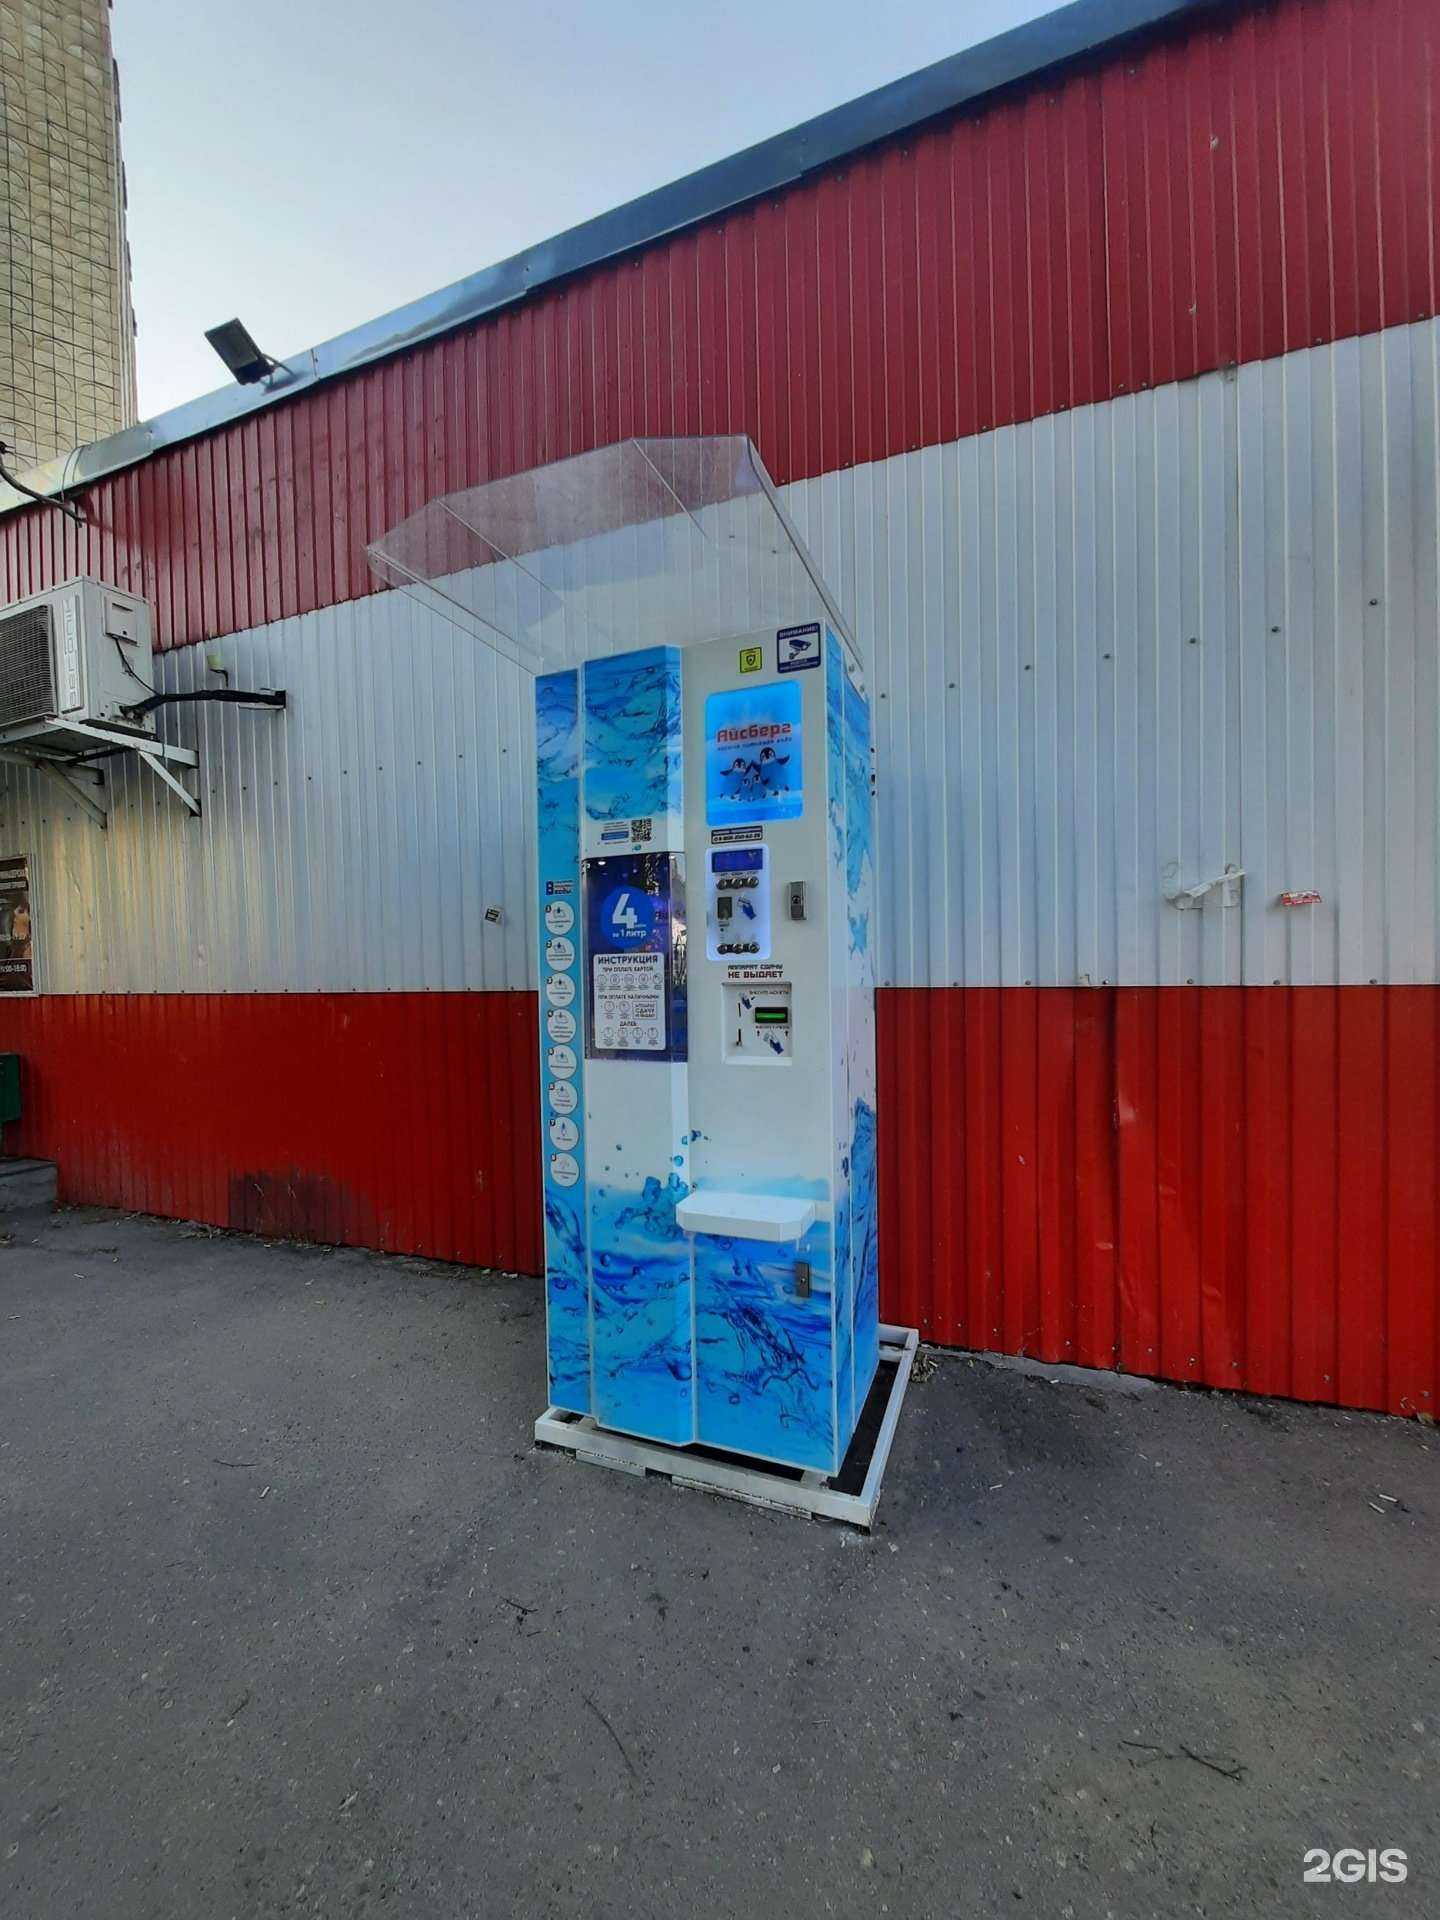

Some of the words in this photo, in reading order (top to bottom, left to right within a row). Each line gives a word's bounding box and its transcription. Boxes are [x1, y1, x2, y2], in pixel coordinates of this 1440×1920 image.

[717, 723, 791, 743] Айсберг
[612, 893, 638, 929] 4
[626, 930, 647, 939] литр
[598, 955, 658, 965] ИНСТРУКЦИЯ
[728, 971, 740, 979] НЕ
[743, 970, 783, 978] ВЫДАЕТ
